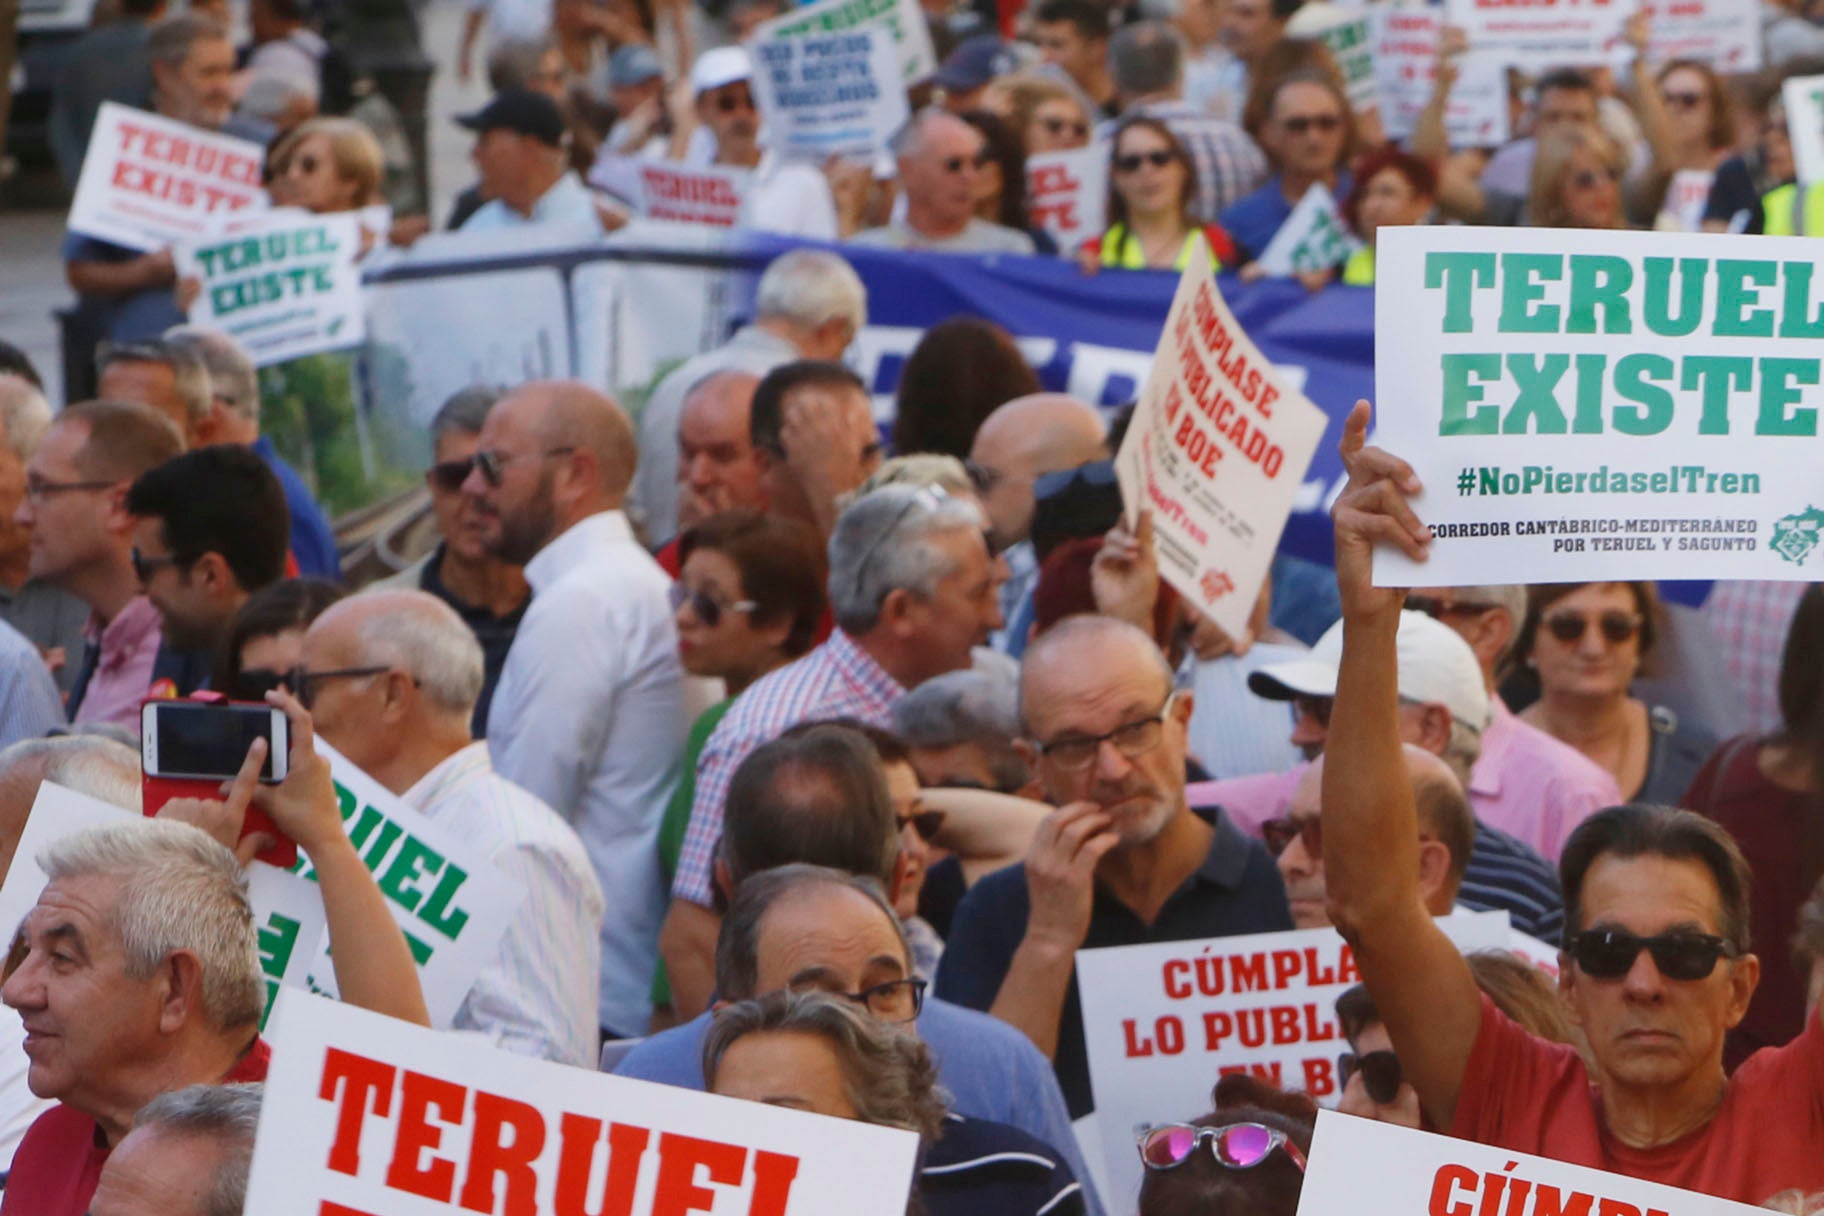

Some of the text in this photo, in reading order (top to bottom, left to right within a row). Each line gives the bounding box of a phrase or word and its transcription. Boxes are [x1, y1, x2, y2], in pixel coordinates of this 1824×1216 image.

[1438, 352, 1822, 436] EXISTE
[1174, 411, 1225, 480] BOE
[1457, 465, 1761, 496] #NoPierdaselTren
[1427, 521, 1511, 539] CORREDOR
[1553, 537, 1757, 553] POR TERUEL Y SAGUNTO
[1121, 1014, 1184, 1058] LO
